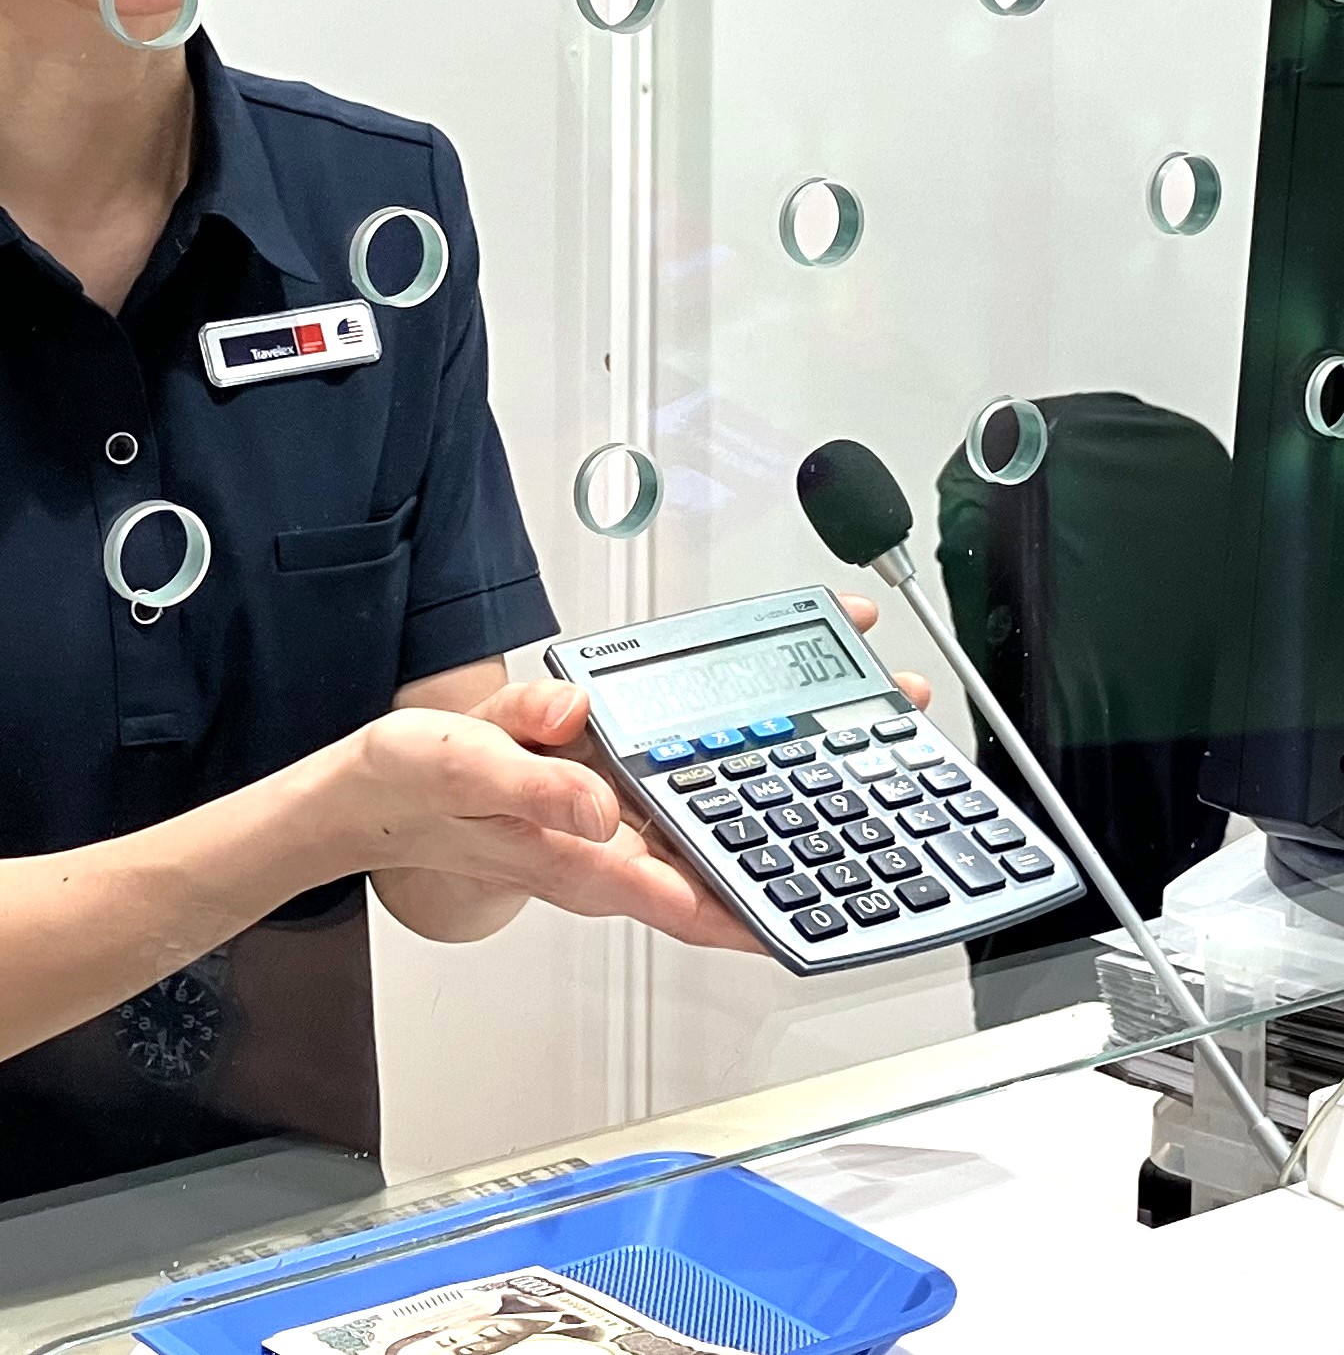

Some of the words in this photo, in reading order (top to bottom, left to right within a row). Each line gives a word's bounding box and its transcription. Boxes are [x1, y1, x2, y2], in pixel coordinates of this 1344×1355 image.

[249, 344, 297, 361] Travelex
[579, 637, 641, 660] Canon
[777, 636, 847, 688] 305
[782, 742, 808, 758] GT
[830, 794, 849, 812] 9
[781, 808, 803, 826] 8
[729, 821, 747, 839] 7
[861, 822, 879, 840] 6
[808, 834, 829, 853] 5
[760, 850, 777, 868] 4
[885, 851, 907, 869] 3
[835, 865, 858, 884] 2
[784, 879, 804, 896] 1
[855, 892, 891, 915] 00
[810, 909, 832, 928] 0
